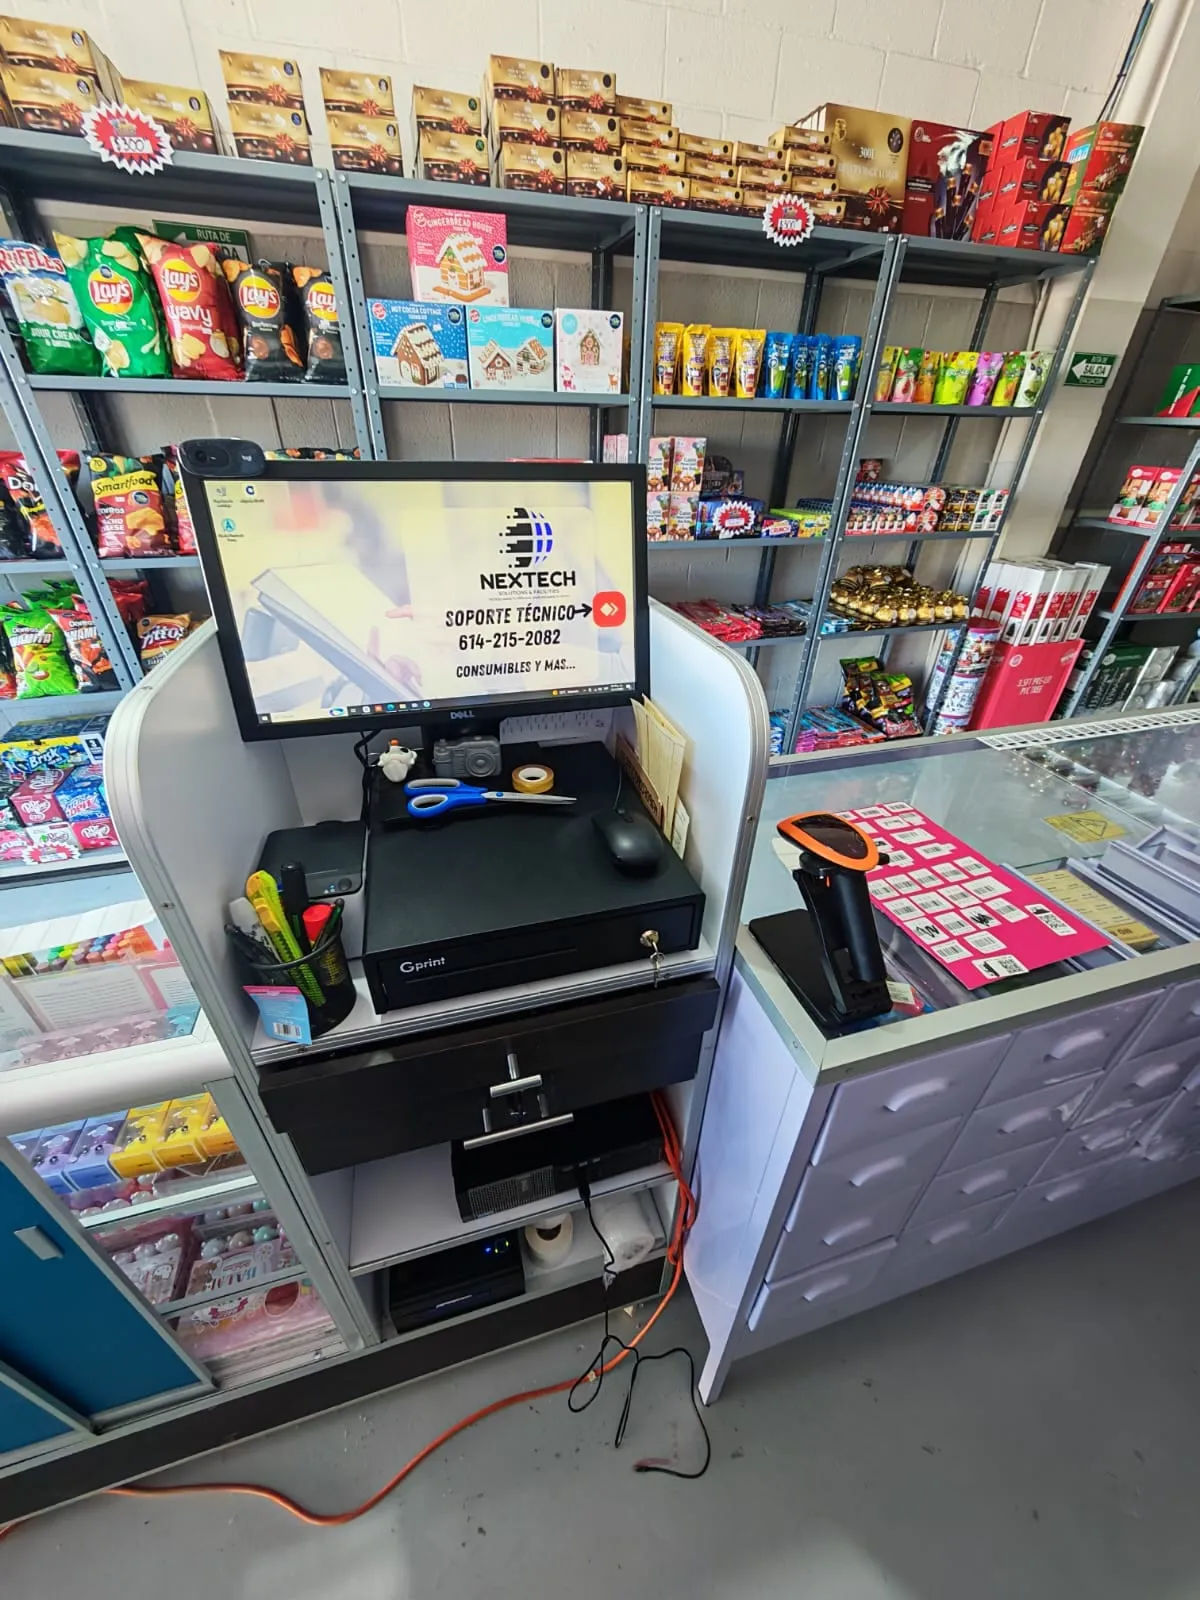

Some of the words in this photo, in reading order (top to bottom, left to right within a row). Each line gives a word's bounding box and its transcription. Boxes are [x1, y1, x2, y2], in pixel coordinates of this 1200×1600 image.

[196, 229, 218, 241] RUTA
[220, 231, 231, 242] DE
[164, 268, 198, 291] Lay's
[92, 281, 133, 303] Lay's
[242, 286, 279, 307] Lay's
[167, 303, 212, 326] wavy
[95, 476, 154, 495] Smartfood
[480, 571, 576, 590] NEXTECH
[445, 607, 511, 627] SOPORTE
[517, 602, 576, 624] TÉCNICO
[458, 629, 561, 650] 614-215-2082
[456, 661, 531, 678] CONSUMIBLES
[535, 660, 541, 671] Y
[544, 658, 576, 671] MAS...
[450, 711, 475, 719] DELL
[29, 748, 61, 768] Brisk
[399, 956, 446, 974] Gprint
